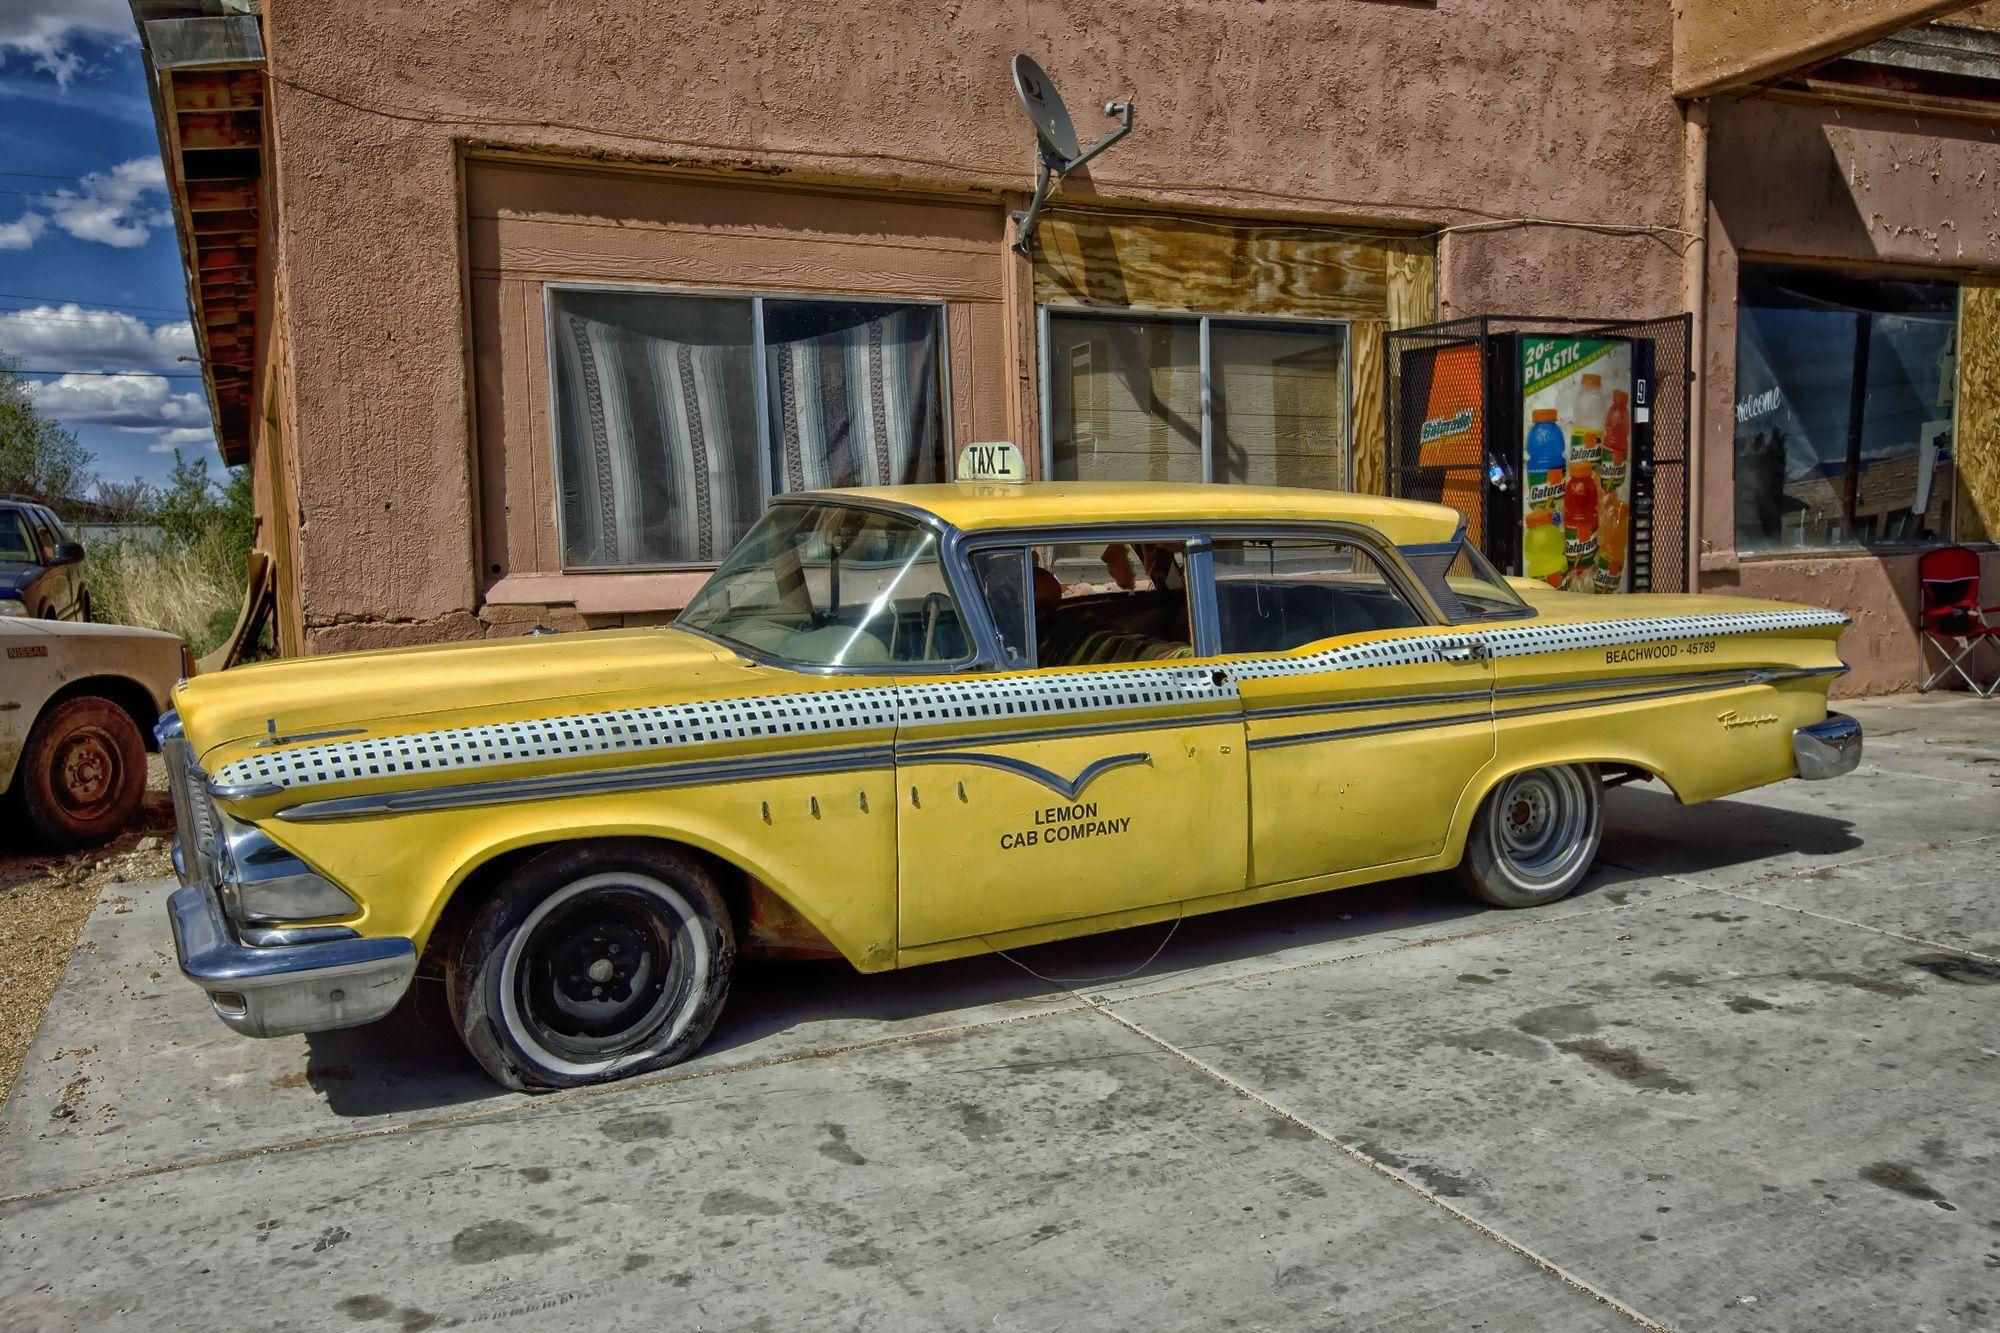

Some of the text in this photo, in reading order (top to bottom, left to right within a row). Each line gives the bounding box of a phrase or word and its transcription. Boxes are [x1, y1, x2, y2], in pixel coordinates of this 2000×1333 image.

[1524, 342, 1580, 385] PLASTIC
[969, 446, 1011, 475] TAXI
[1570, 447, 1600, 461] Gatorad
[7, 646, 49, 659] NISSAN
[1606, 645, 1677, 664] BEACHWOOD
[1687, 640, 1716, 655] 45789
[1034, 802, 1098, 825] LEMON
[1000, 817, 1131, 850] CAB COMPANY
